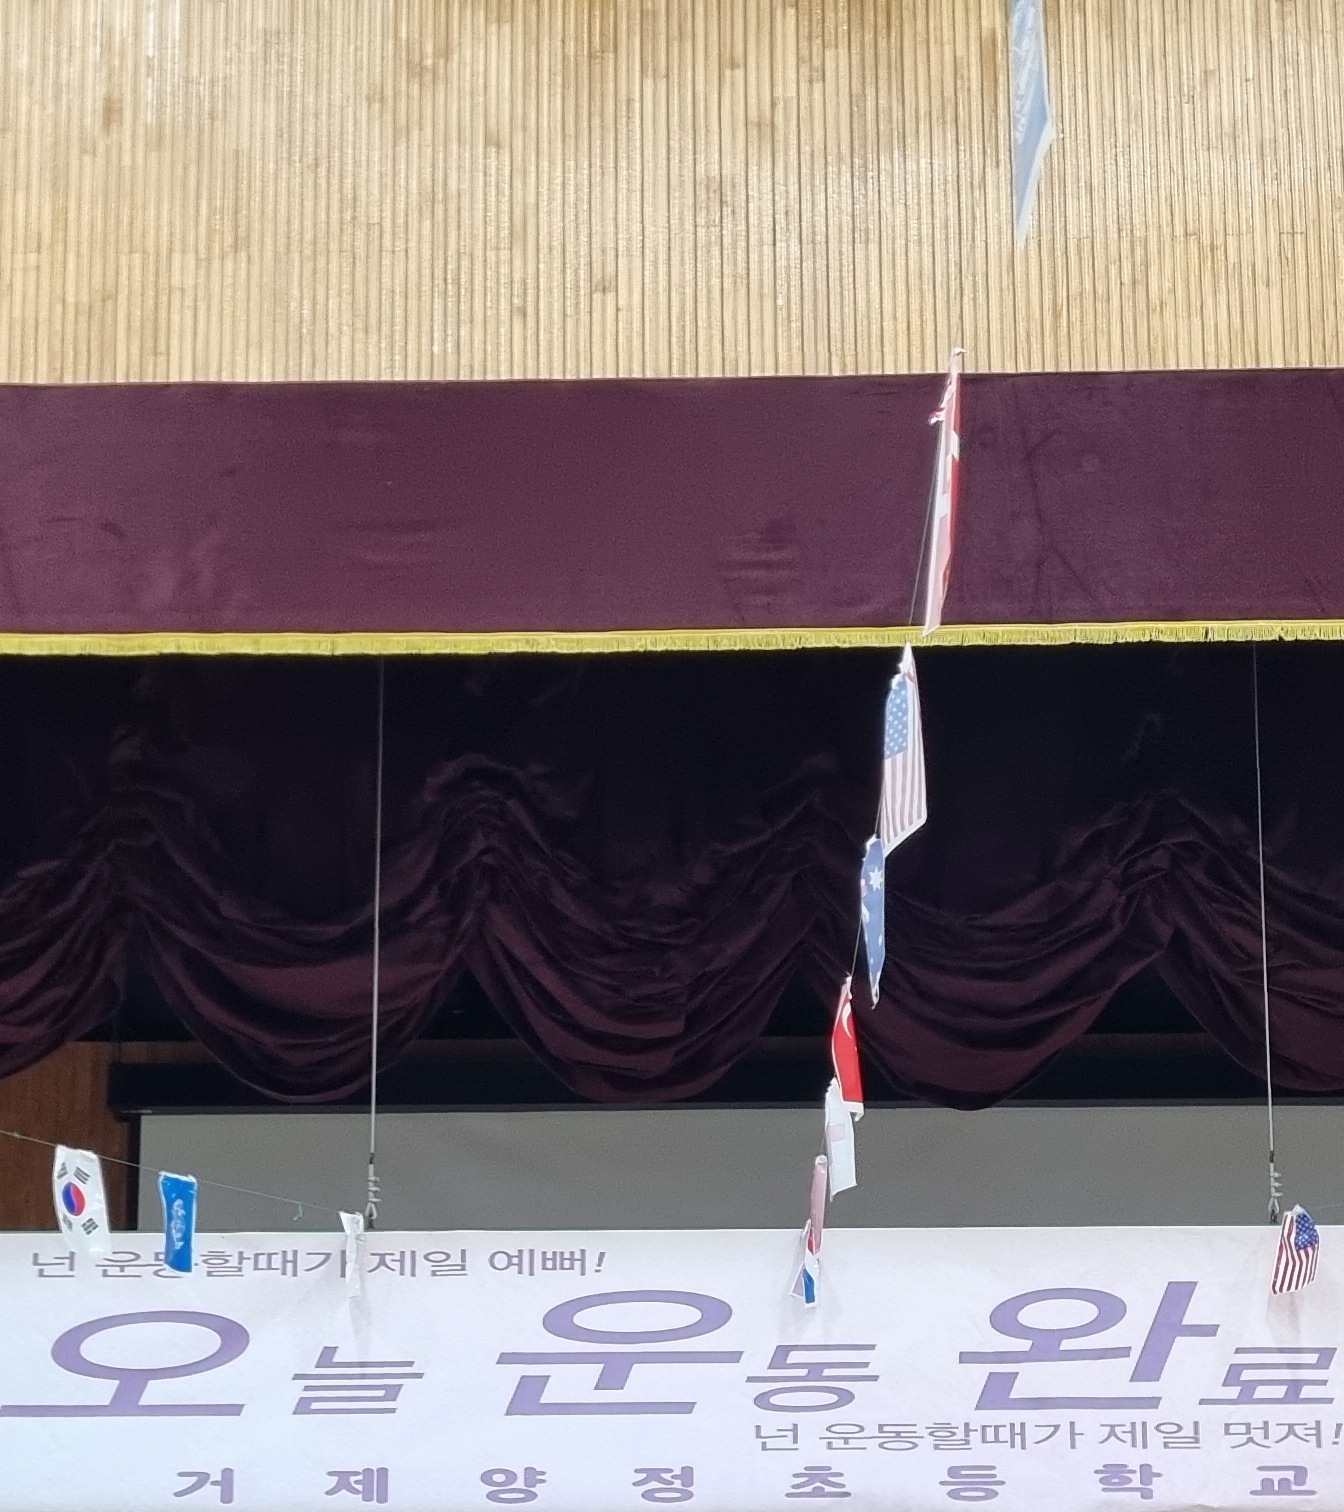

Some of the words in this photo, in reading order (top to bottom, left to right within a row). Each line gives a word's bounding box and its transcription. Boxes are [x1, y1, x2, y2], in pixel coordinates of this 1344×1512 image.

[31, 1251, 76, 1278] 넌
[367, 1249, 468, 1277] 제일
[487, 1248, 606, 1277] 예뻐!
[495, 1288, 880, 1417] 운동
[958, 1281, 1338, 1411] 완료
[754, 1421, 800, 1451] 넌
[817, 1421, 1085, 1451] 운동할때가
[1099, 1420, 1203, 1451] 제일
[1222, 1419, 1344, 1450] 멋져!
